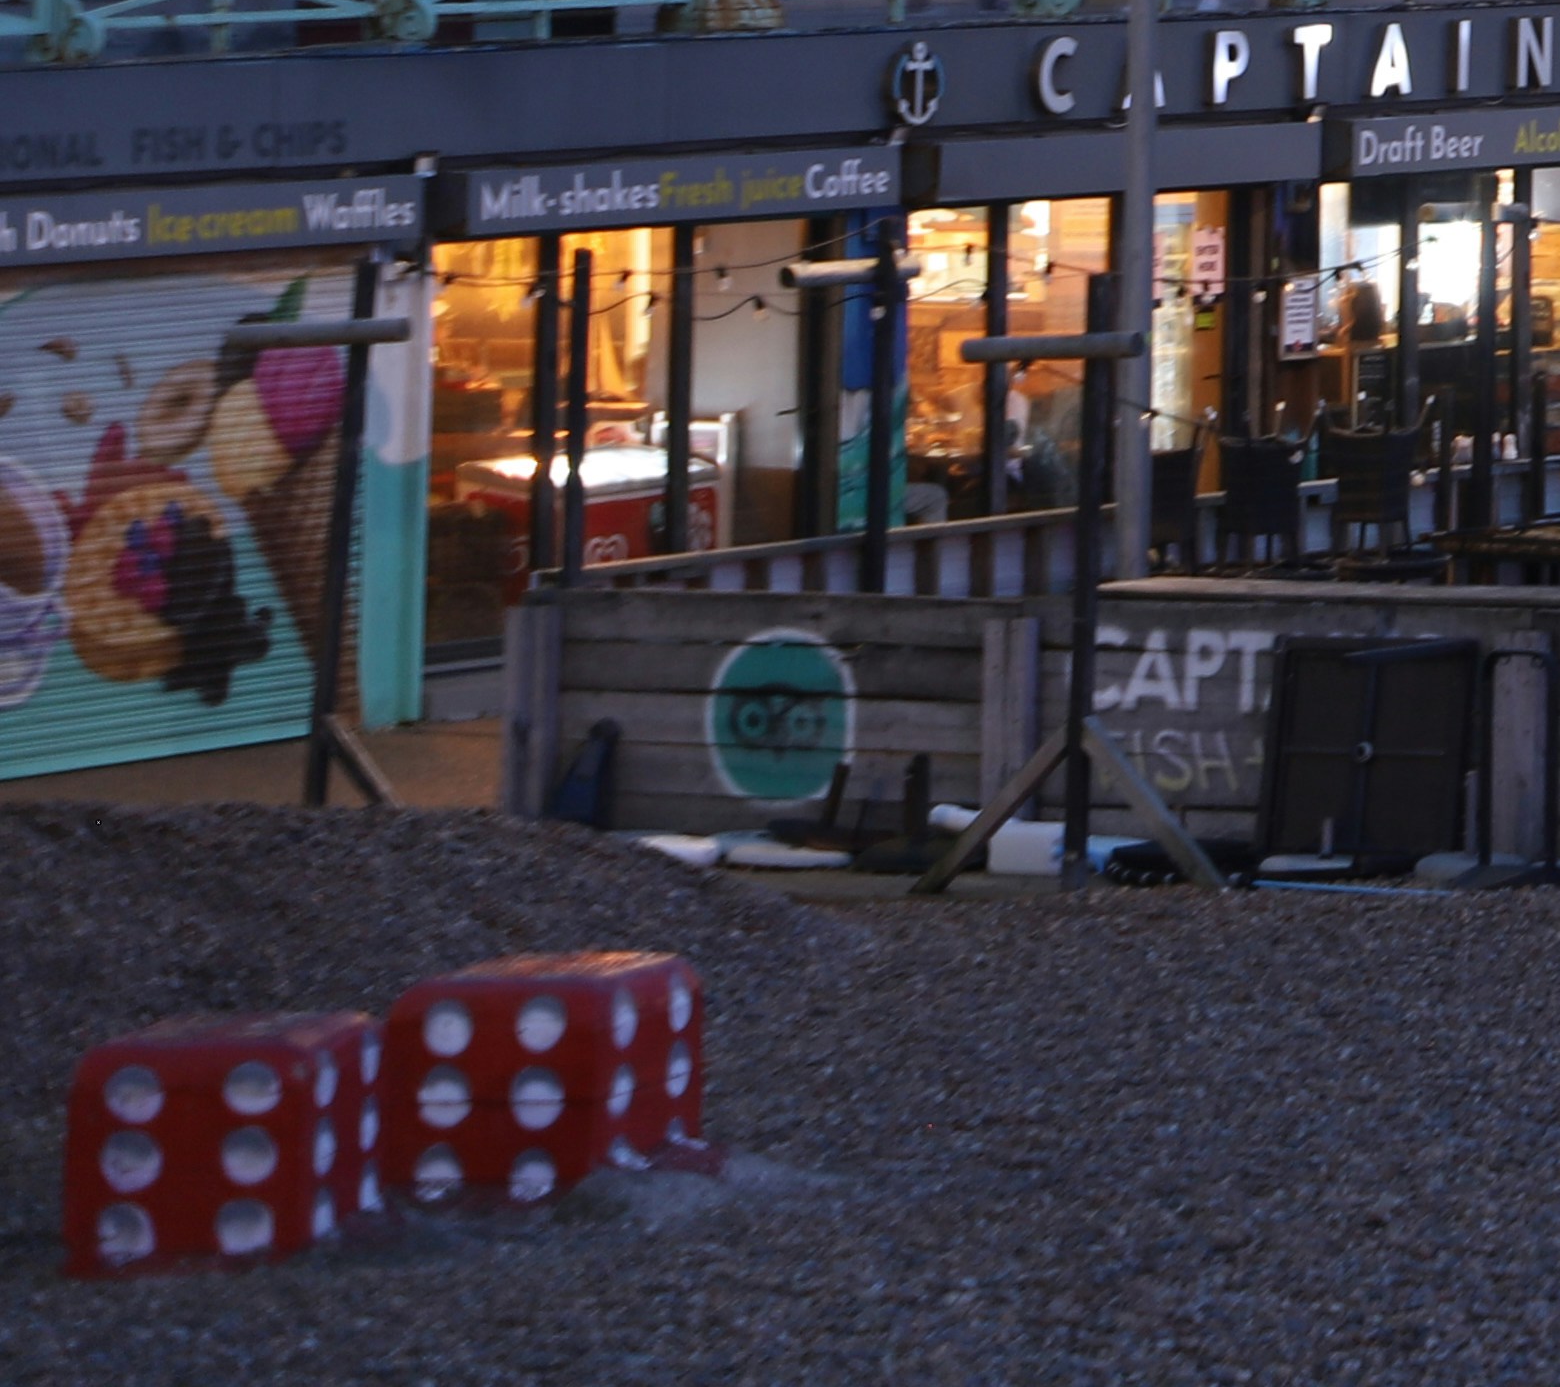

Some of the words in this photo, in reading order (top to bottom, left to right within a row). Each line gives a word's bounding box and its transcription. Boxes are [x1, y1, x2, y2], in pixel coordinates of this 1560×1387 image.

[131, 126, 207, 165] FISH
[217, 125, 242, 161] &
[251, 120, 349, 157] CHIPS
[1359, 125, 1425, 166] Draft
[1430, 125, 1484, 159] Beer
[27, 209, 141, 252] Donuts
[304, 187, 417, 231] Waffles
[480, 169, 659, 221] Milk-shakes
[659, 168, 735, 210] Fresh
[740, 169, 801, 210] juice
[805, 157, 891, 200] Coffee
[1065, 626, 1272, 713] CAPT
